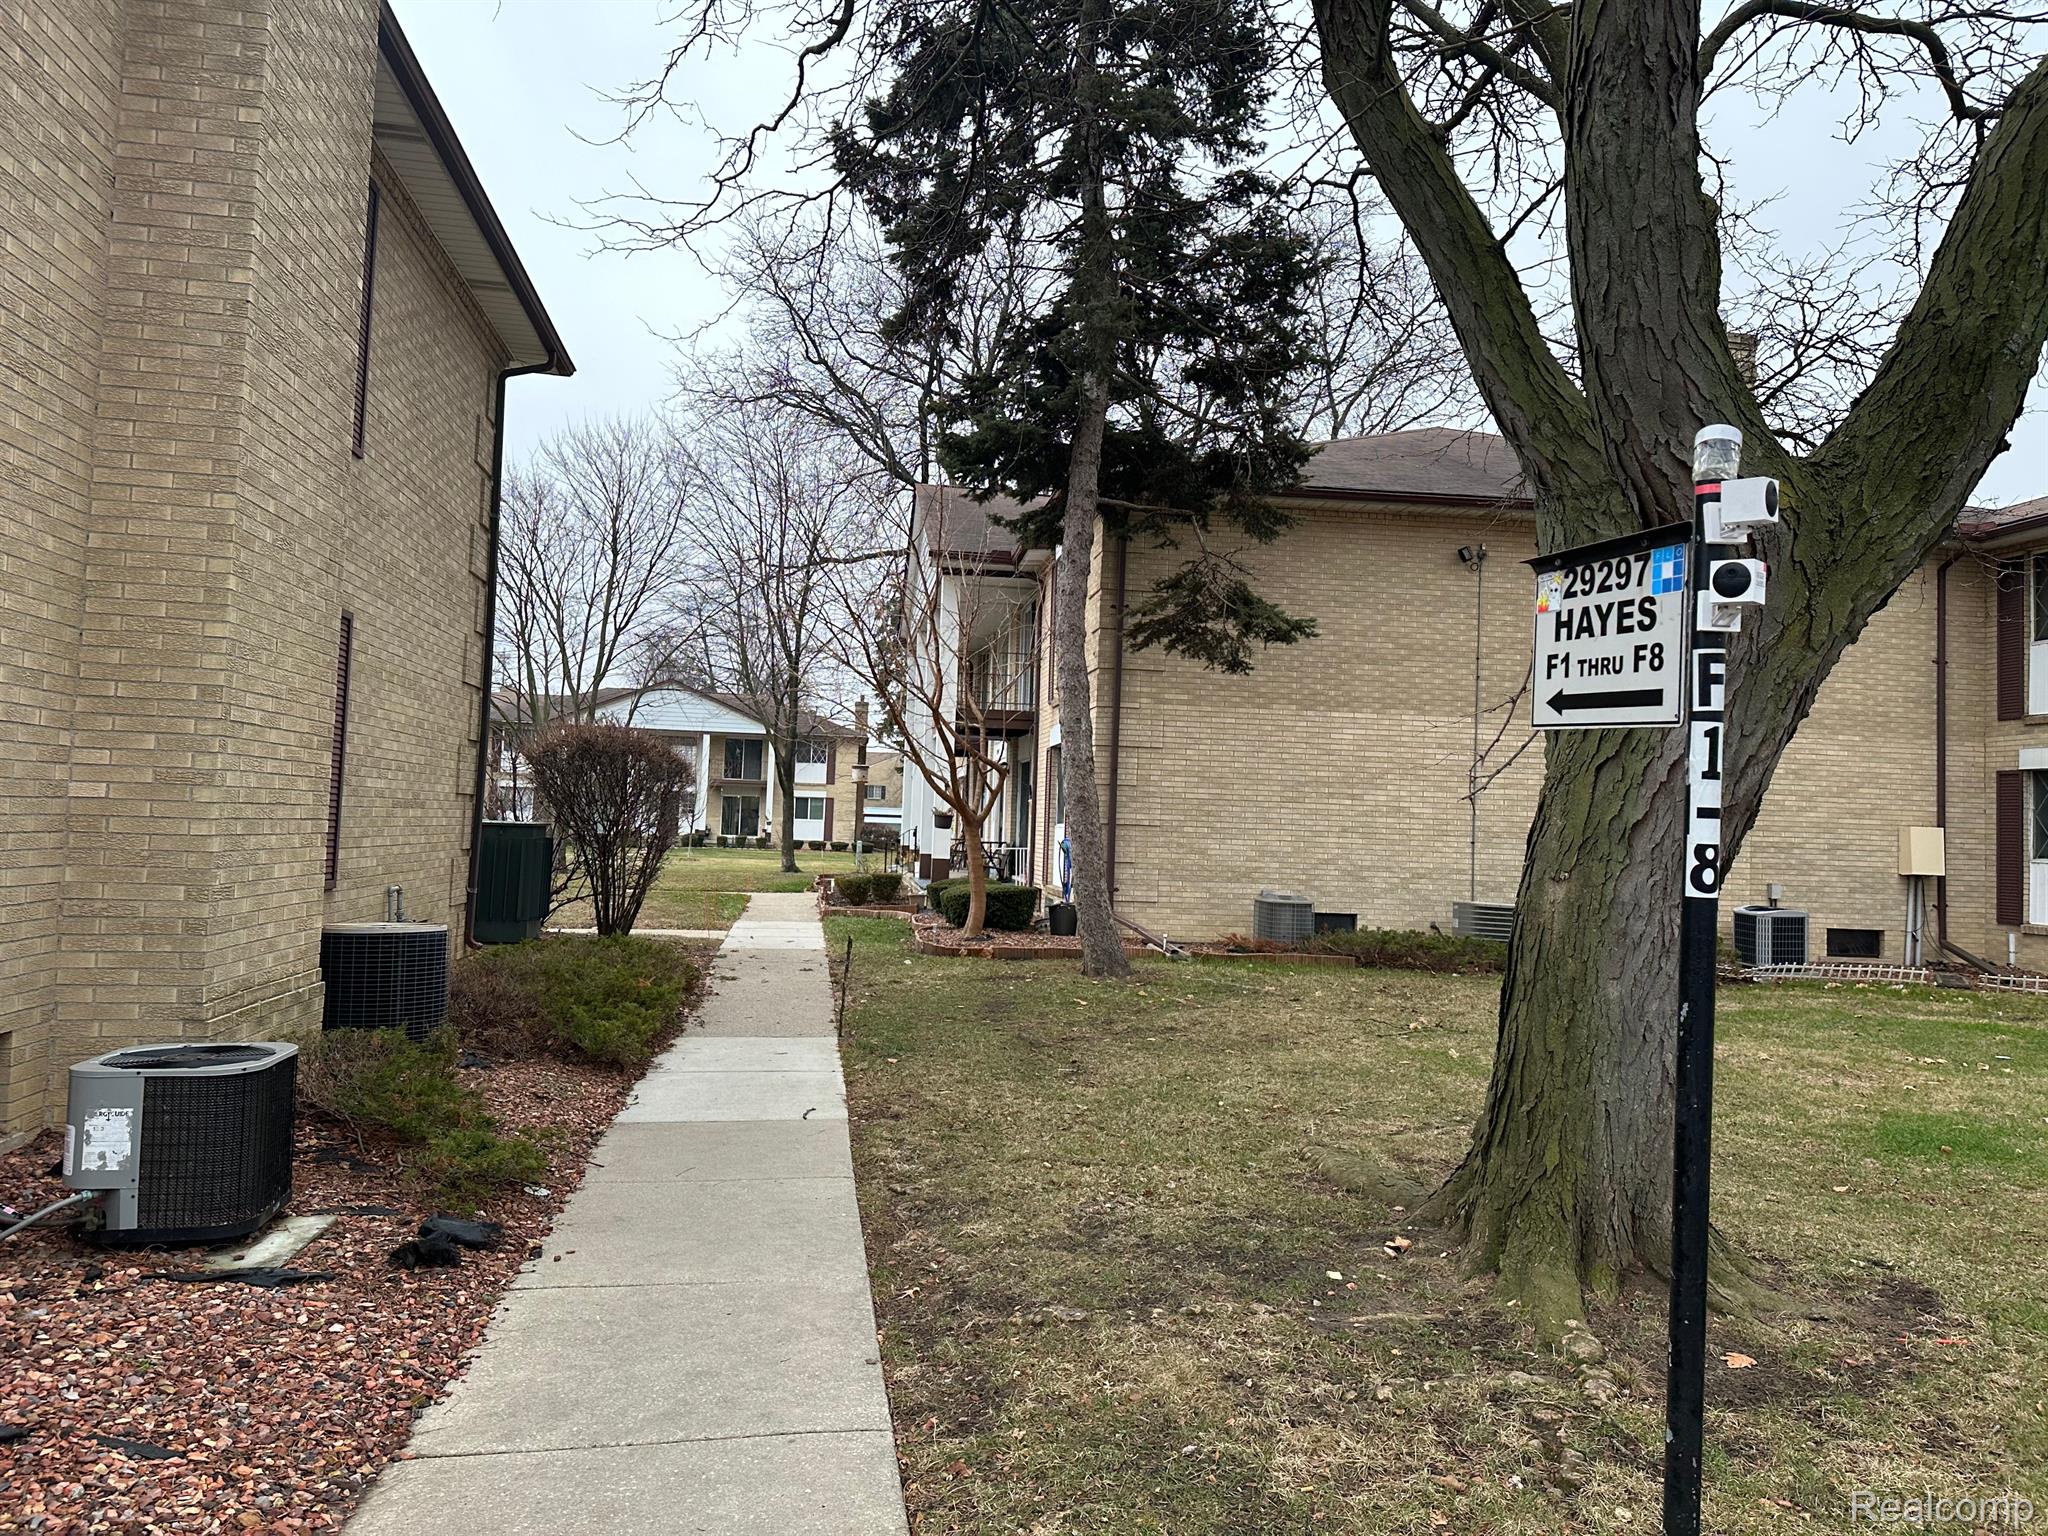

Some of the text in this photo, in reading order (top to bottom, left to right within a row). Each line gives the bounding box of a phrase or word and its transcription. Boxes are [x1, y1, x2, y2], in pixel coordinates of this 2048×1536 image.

[1563, 554, 1651, 600] 29297
[1555, 595, 1657, 642] HAYES
[1546, 642, 1664, 679] F1 THRU F8
